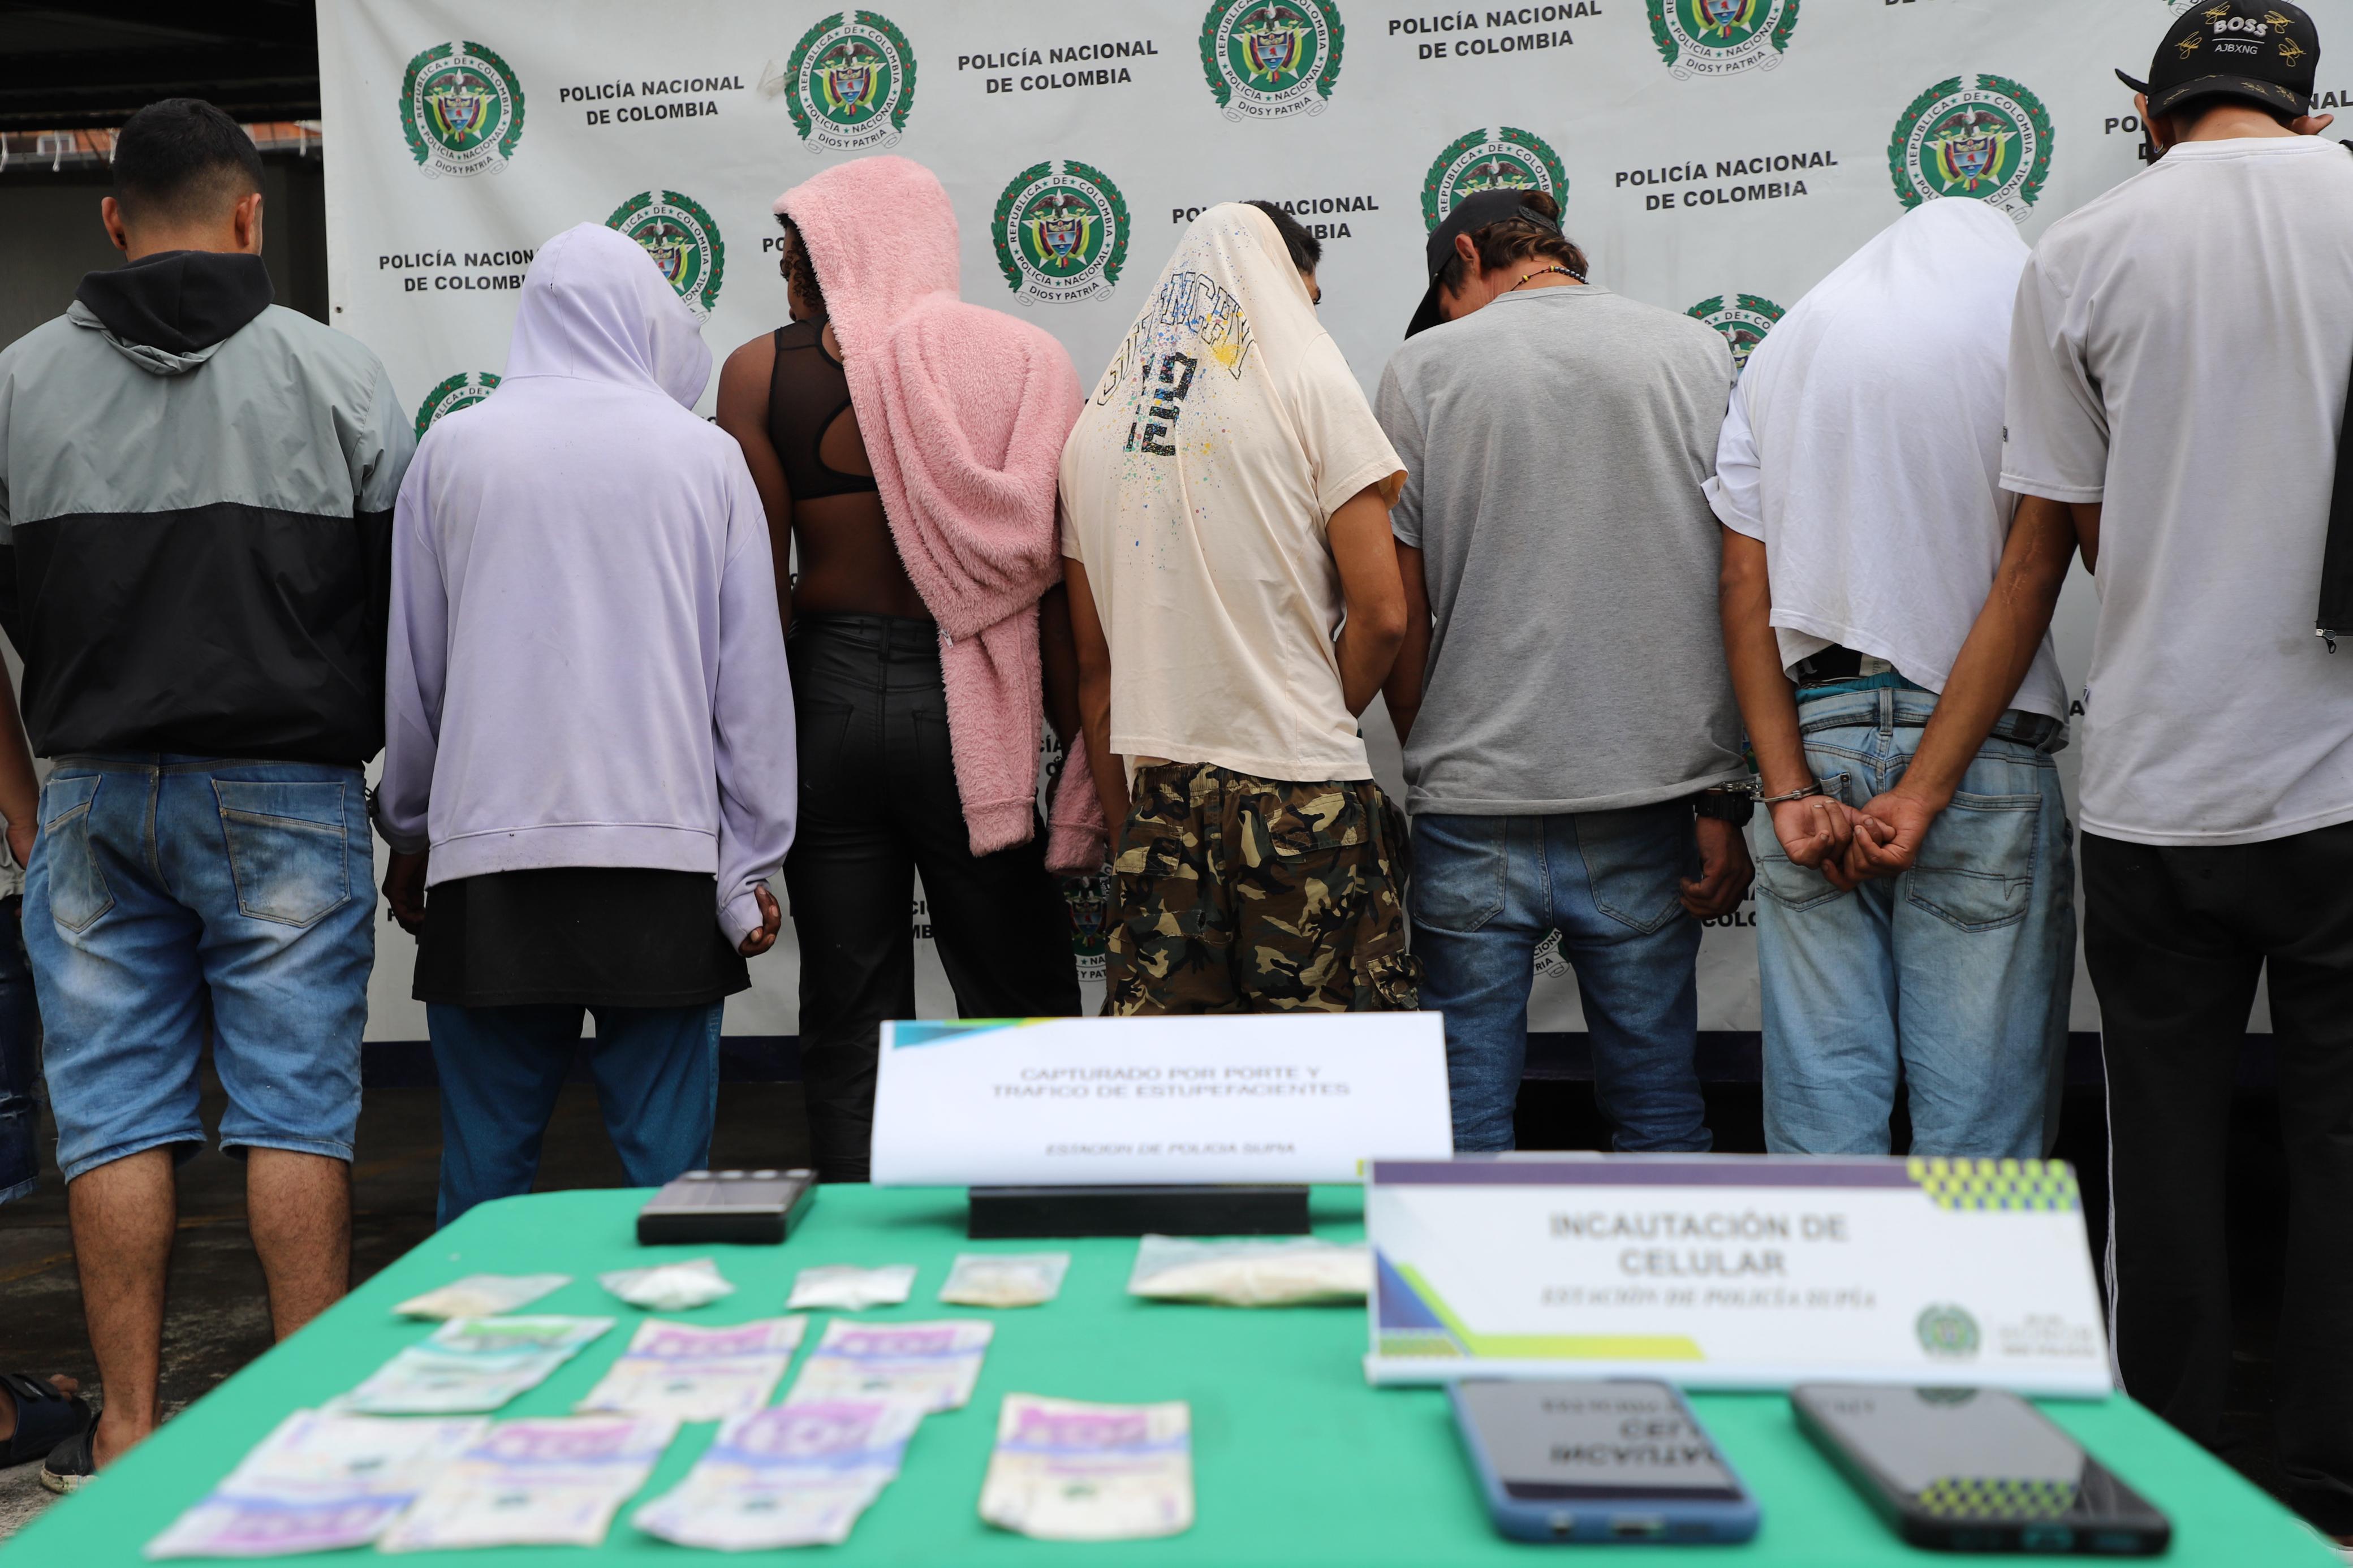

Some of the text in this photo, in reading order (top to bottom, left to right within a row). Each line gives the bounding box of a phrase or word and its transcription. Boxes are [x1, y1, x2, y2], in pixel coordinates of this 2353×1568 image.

[1299, 0, 1326, 50] OLOMBIA
[1389, 0, 1602, 35] POLICÍA NACIONAL
[2214, 16, 2268, 37] BOSS
[1419, 30, 1574, 59] DE COLOMBIA
[1726, 15, 1778, 57] NACIONAL
[2214, 44, 2258, 54] AJBXNG
[868, 31, 900, 84] COLOMBIA
[958, 40, 1158, 71] POLICÍA NACIONAL
[1686, 59, 1712, 72] DIOS
[1726, 51, 1765, 71] PATRIA
[477, 63, 509, 115] COLOMBIA
[560, 76, 744, 102] POLICÍA NACIONAL
[985, 68, 1131, 94] DE COLOMBIA
[1275, 63, 1322, 101] NACIONAL
[587, 101, 718, 126] DE COLOMBIA
[852, 97, 897, 132] NACIONAL
[1238, 101, 1262, 115] DIOS
[1275, 97, 1312, 115] PATRIA
[818, 133, 842, 147] DIOS
[854, 129, 887, 146] PATRIA
[1994, 97, 2032, 154] COLOMBIA
[463, 125, 505, 159] NACIONAL
[436, 160, 457, 174] DIOS
[466, 156, 493, 173] PATRIA
[1516, 149, 1549, 191] COLOMB
[1615, 150, 1838, 188] POLICÍA NACIONAL
[1645, 180, 1808, 211] DE COLOMBIA
[1984, 169, 2027, 205] CIONAL
[1079, 182, 1113, 236] COLOMBIA
[677, 211, 709, 265] COLOMBIA
[379, 249, 535, 269] POLICÍA NACION
[1065, 250, 1110, 286] NACIONAL
[404, 275, 524, 292] DE COLOMB
[682, 277, 706, 304] IONAL
[1029, 286, 1053, 300] DIOS
[1065, 283, 1100, 300] PATRIA
[433, 393, 459, 422] BLICA
[1020, 1066, 1321, 1082] CAPTURADO POR PORTE Y
[1096, 1085, 1127, 1099] DE
[1135, 1083, 1351, 1098] ESTUPEFACIENTES
[1550, 1208, 1849, 1241] INCAUTACIÓN DE
[1619, 1249, 1786, 1276] CELULAR
[1665, 1288, 1695, 1307] DE
